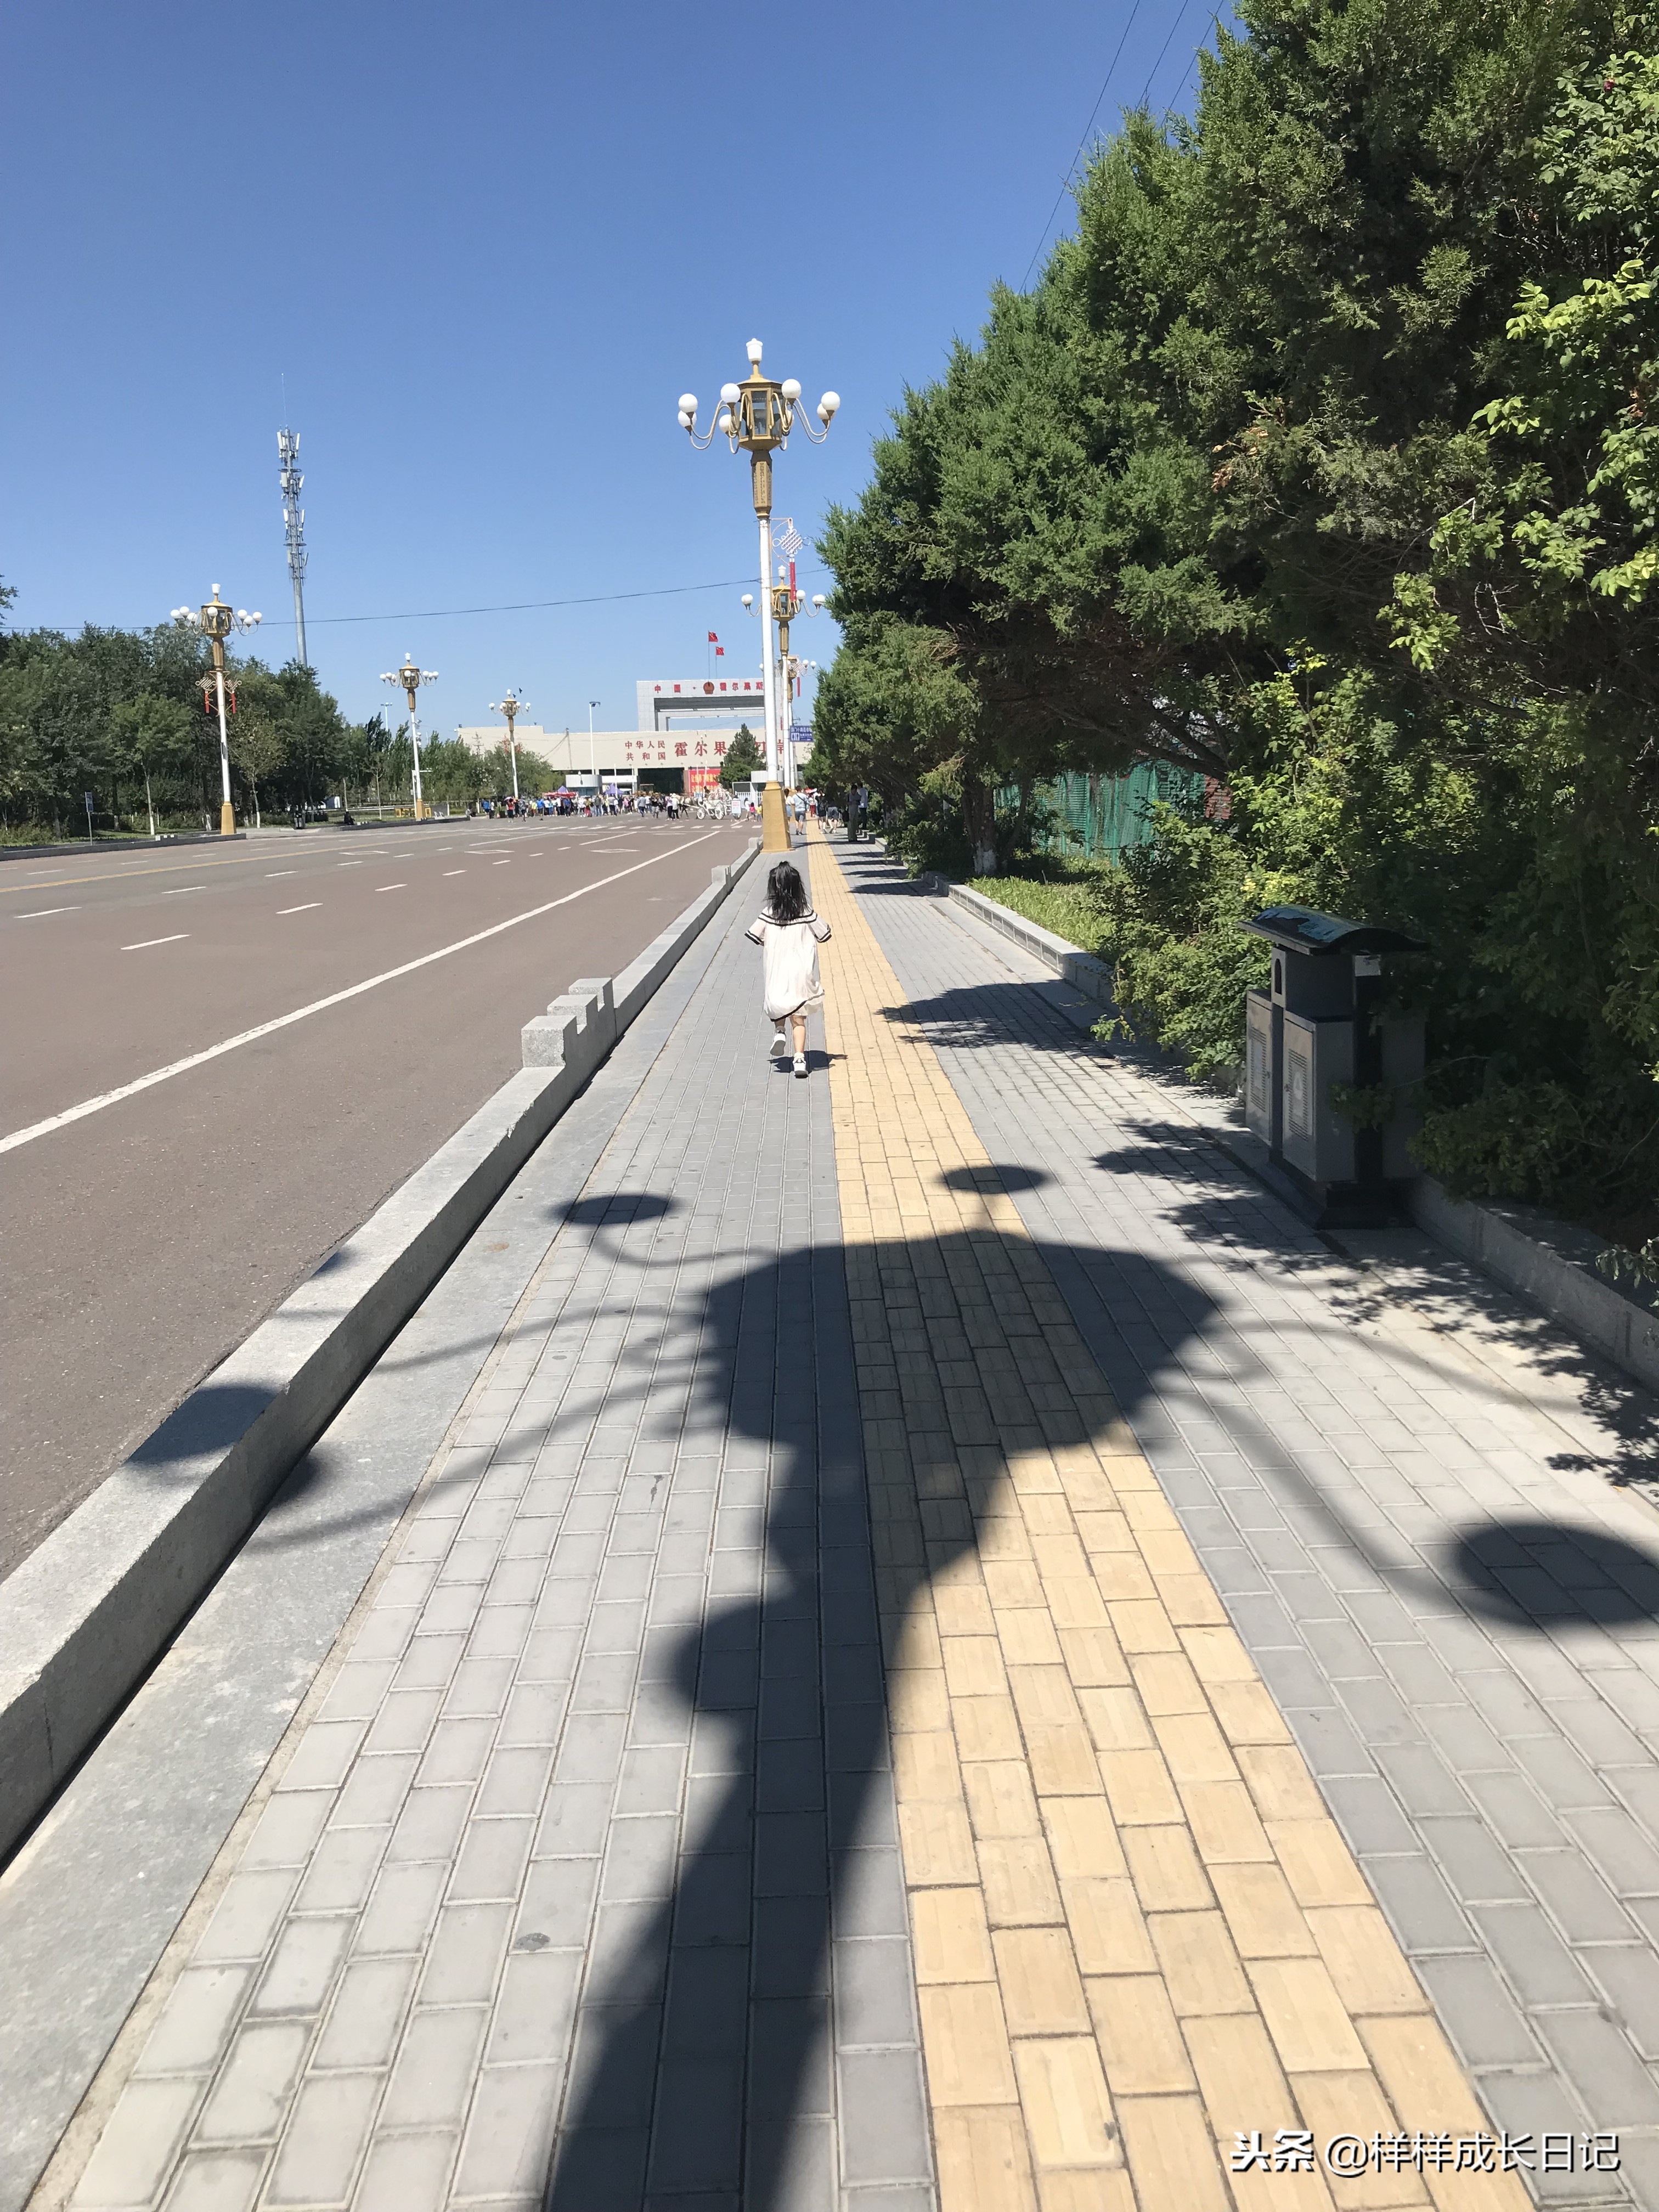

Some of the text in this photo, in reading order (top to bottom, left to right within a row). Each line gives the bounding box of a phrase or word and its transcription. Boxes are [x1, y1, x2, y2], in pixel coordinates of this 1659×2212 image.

[625, 741, 665, 749] 中华人民
[675, 739, 784, 757] 霍尔果口岸
[627, 752, 665, 761] 共和国
